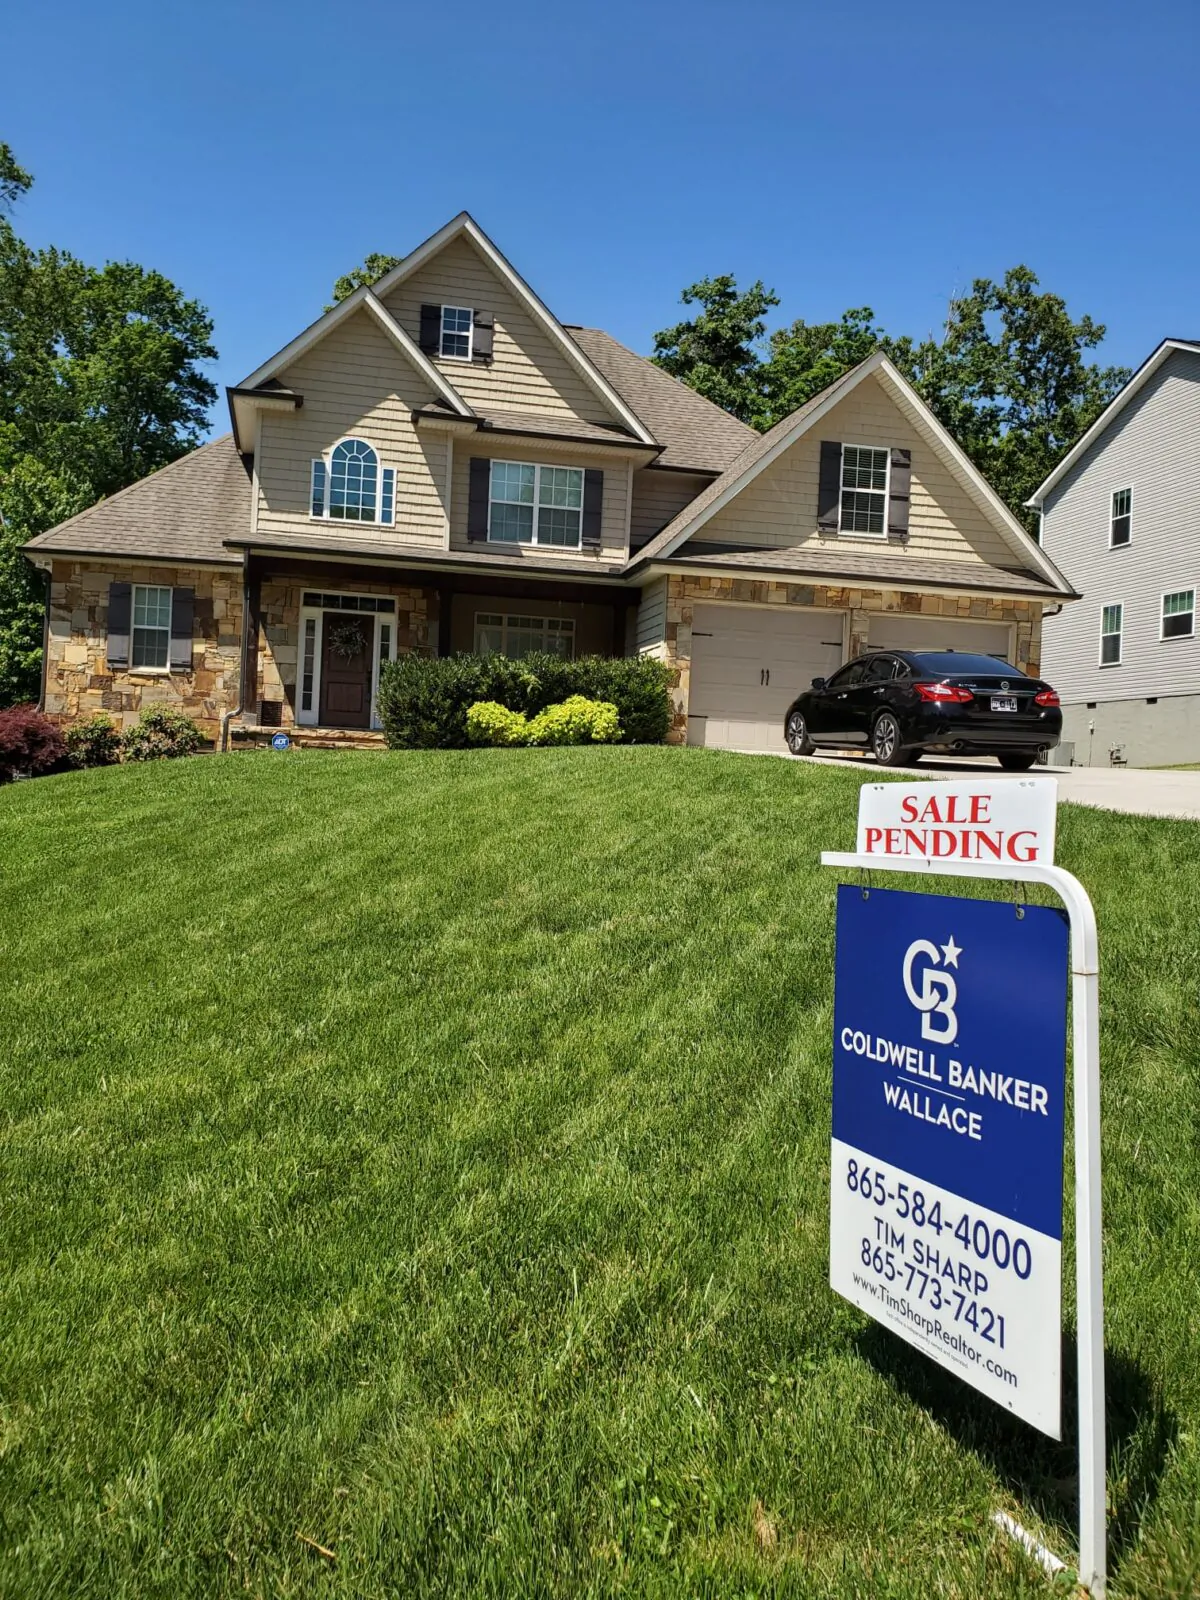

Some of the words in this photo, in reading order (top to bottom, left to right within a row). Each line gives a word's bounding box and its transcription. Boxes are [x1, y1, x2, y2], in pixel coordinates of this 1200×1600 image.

[865, 828, 1040, 862] PENDING
[900, 795, 992, 824] SALE
[841, 1027, 942, 1082] COLDWELL
[949, 1059, 1048, 1116] BANKER
[883, 1081, 983, 1141] WALLACE
[847, 1158, 1033, 1280] 865-584-4000
[873, 1216, 905, 1254] TIM
[913, 1239, 989, 1296] SHARP
[852, 1271, 1018, 1388] www.TimSharpRealtor.com
[861, 1238, 1006, 1350] 865-773-7421
